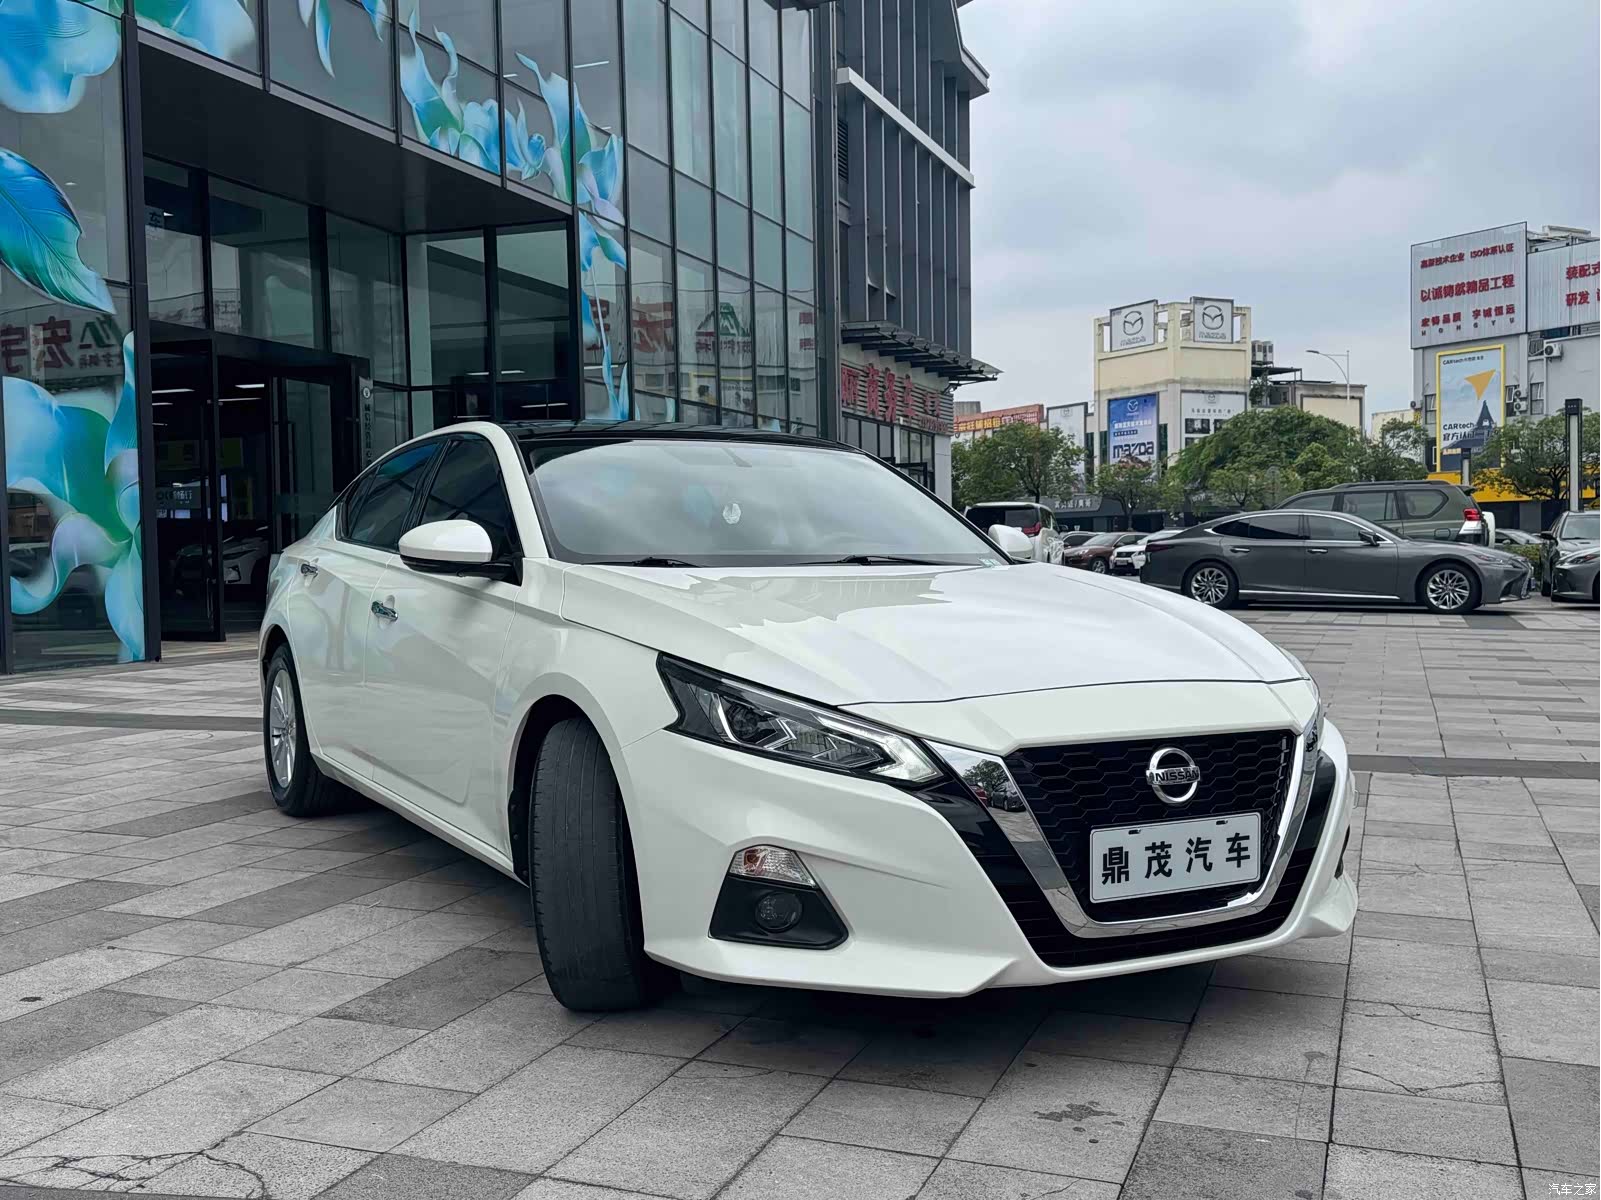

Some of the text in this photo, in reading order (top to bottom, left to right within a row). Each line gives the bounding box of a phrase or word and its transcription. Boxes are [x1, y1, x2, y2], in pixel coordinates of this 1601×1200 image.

[1421, 243, 1514, 269] 高新技术企业 ISO体系认证
[1421, 274, 1515, 302] 以诚铸就精品工程
[1566, 290, 1590, 306] 研发
[1155, 769, 1200, 782] NISSAN
[1102, 833, 1251, 885] 鼎茂汽车
